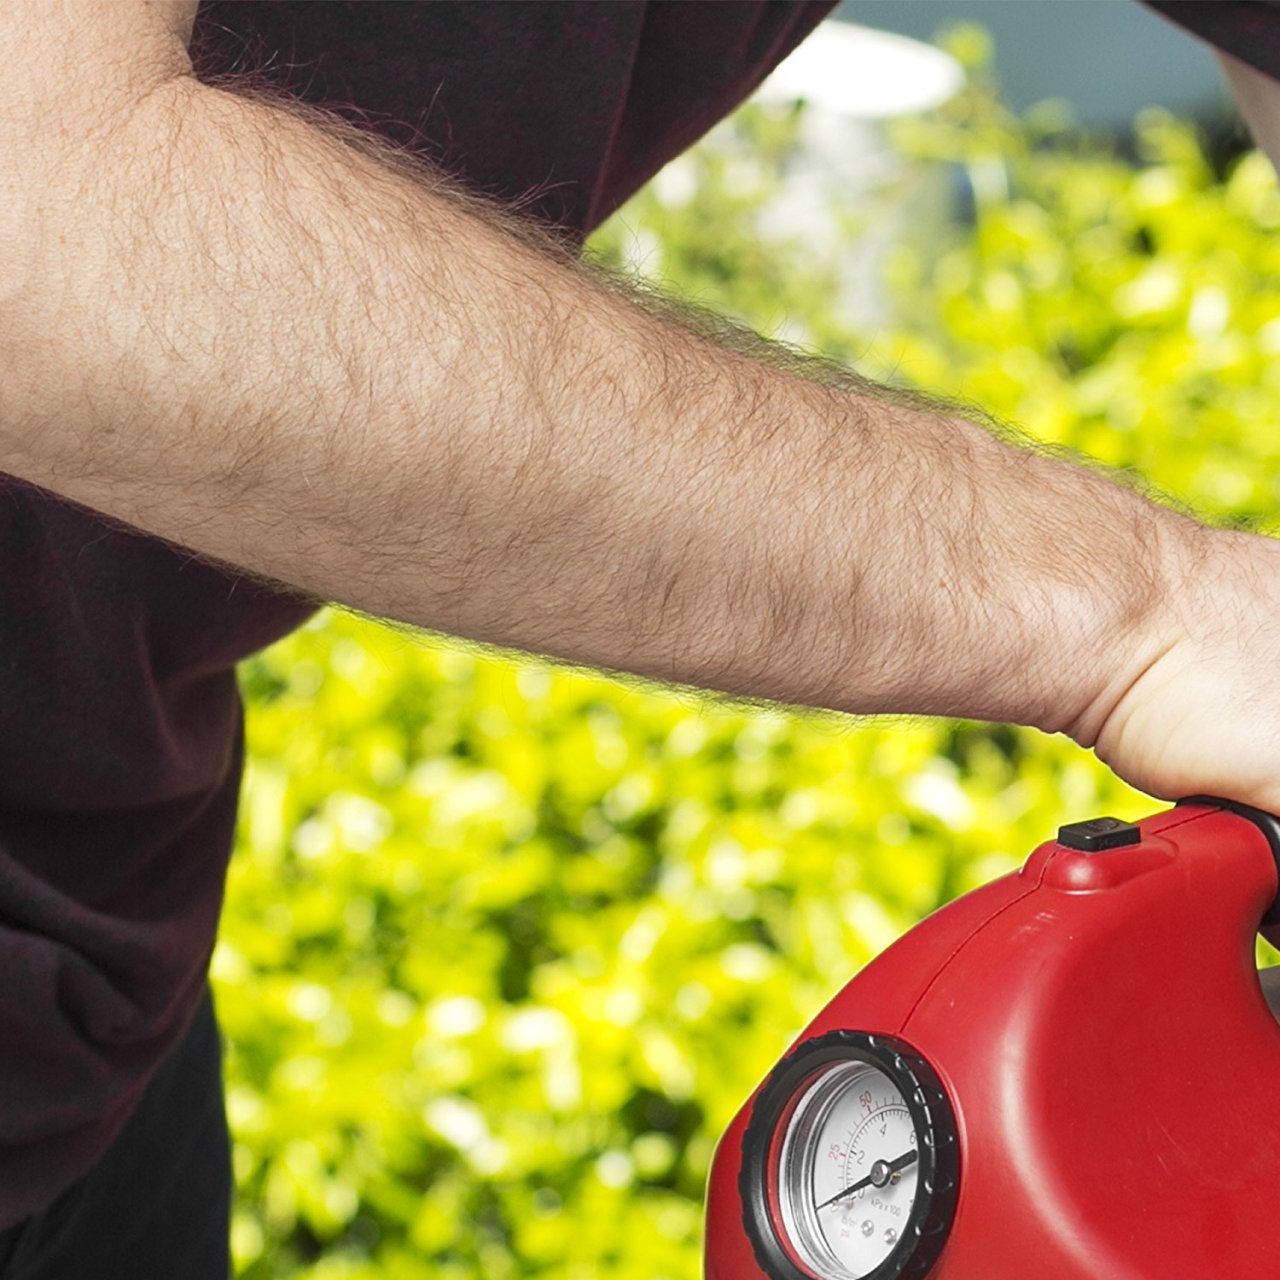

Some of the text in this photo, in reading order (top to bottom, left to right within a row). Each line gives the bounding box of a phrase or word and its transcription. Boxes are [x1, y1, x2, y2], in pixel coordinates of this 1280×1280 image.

[859, 1090, 873, 1107] 50
[880, 1123, 888, 1137] 4
[828, 1143, 841, 1160] 25
[856, 1150, 866, 1165] 2
